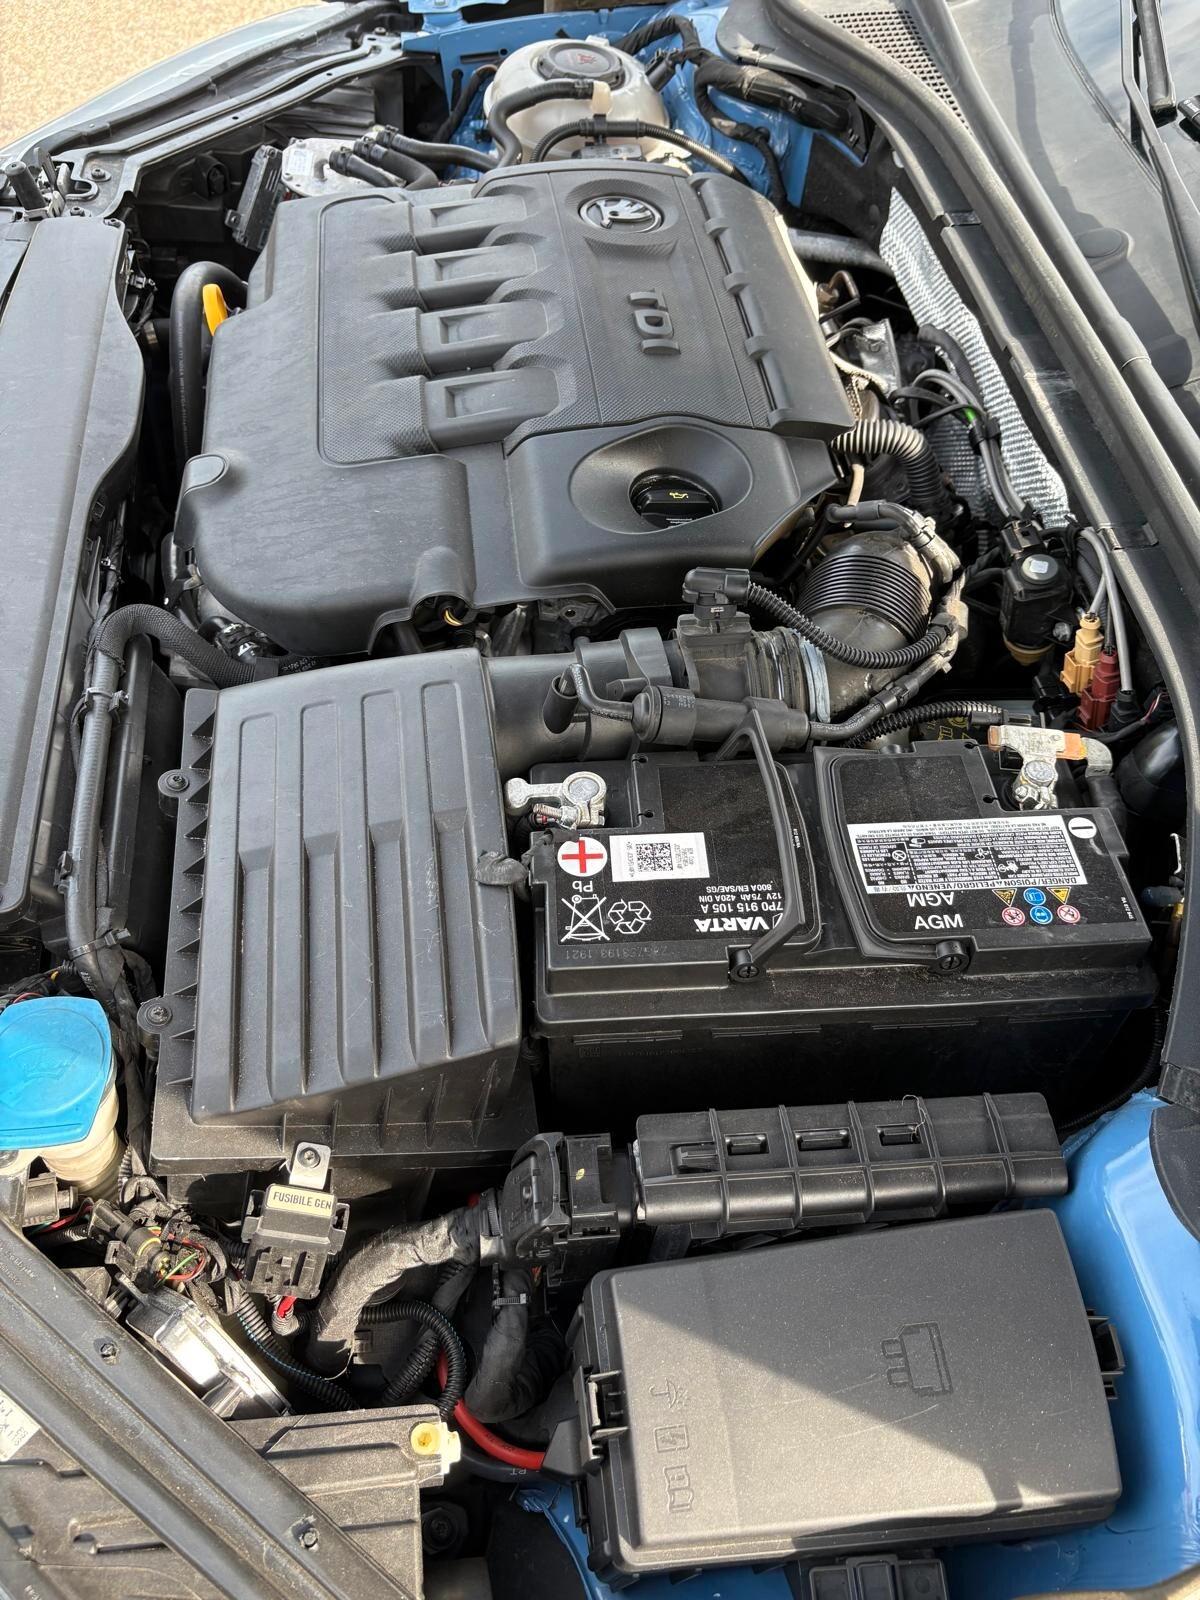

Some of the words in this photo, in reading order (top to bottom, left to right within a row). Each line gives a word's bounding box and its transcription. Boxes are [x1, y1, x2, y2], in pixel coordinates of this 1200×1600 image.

[628, 287, 681, 355] TDI
[572, 880, 593, 892] Pb
[706, 885, 749, 894] EN/SAE/GS
[750, 884, 772, 893] 800A
[698, 895, 713, 903] DIN
[715, 894, 736, 903] 420A
[740, 893, 762, 902] 75Ah
[766, 893, 782, 901] 12V
[906, 891, 954, 908] AGM
[700, 903, 709, 913] A
[712, 903, 734, 913] 105
[736, 902, 758, 913] 915
[693, 916, 769, 933] VARTA
[914, 914, 964, 930] AGM
[565, 948, 593, 959] 1921
[273, 1191, 312, 1207] FUSIBILE
[314, 1198, 332, 1210] GEN
